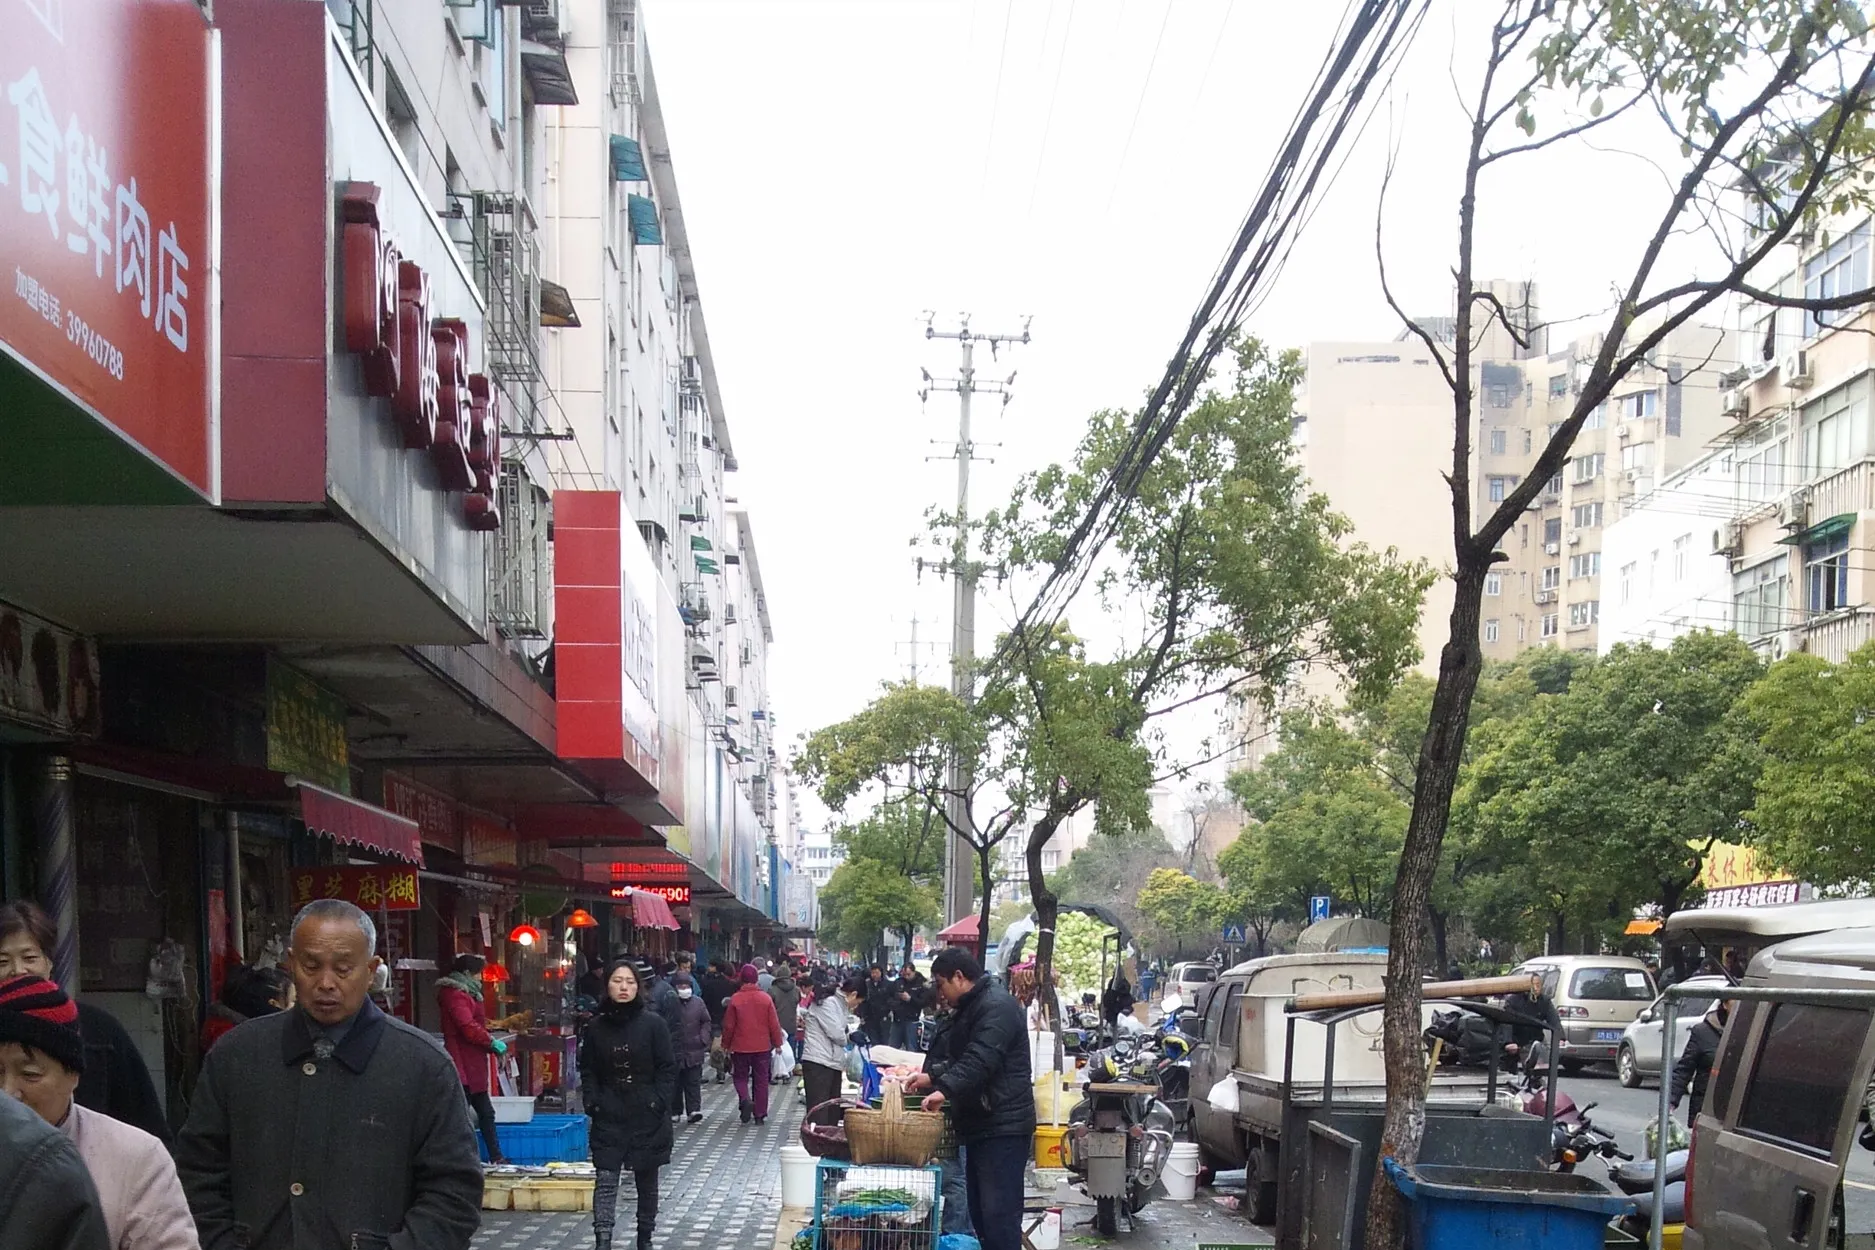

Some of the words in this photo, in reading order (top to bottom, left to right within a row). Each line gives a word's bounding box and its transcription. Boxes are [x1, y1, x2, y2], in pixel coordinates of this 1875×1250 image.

[0, 66, 188, 352] 食鲜肉店
[66, 309, 124, 381] 39960788
[296, 872, 415, 904] 黑芝麻糊
